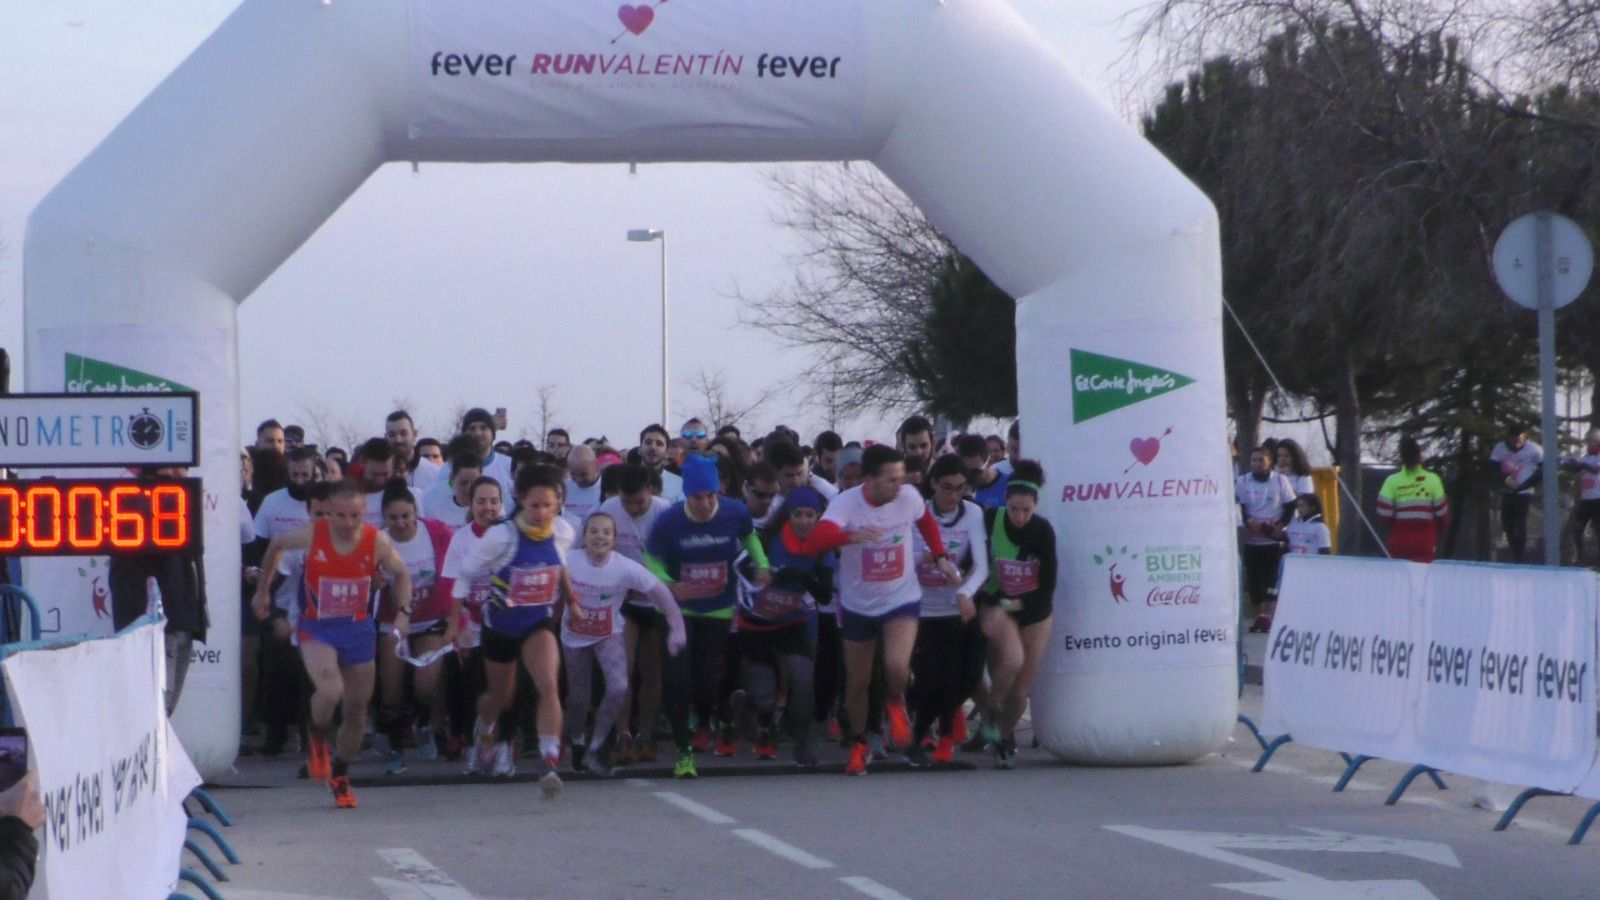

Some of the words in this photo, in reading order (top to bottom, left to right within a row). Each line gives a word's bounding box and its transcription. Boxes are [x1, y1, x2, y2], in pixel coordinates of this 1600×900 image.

[431, 51, 516, 76] fever
[530, 48, 744, 75] RUNVALENTÍN
[756, 51, 842, 79] fever
[1060, 474, 1219, 503] RUNVALENTÍN
[1145, 553, 1202, 572] BUEN
[1064, 634, 1121, 651] Evento
[1126, 629, 1190, 650] original
[1269, 624, 1321, 667] fever
[1323, 630, 1367, 673] fever
[1370, 634, 1414, 680] fever
[1426, 639, 1473, 688] fever
[1479, 645, 1529, 696] fever
[1536, 651, 1588, 704] fever
